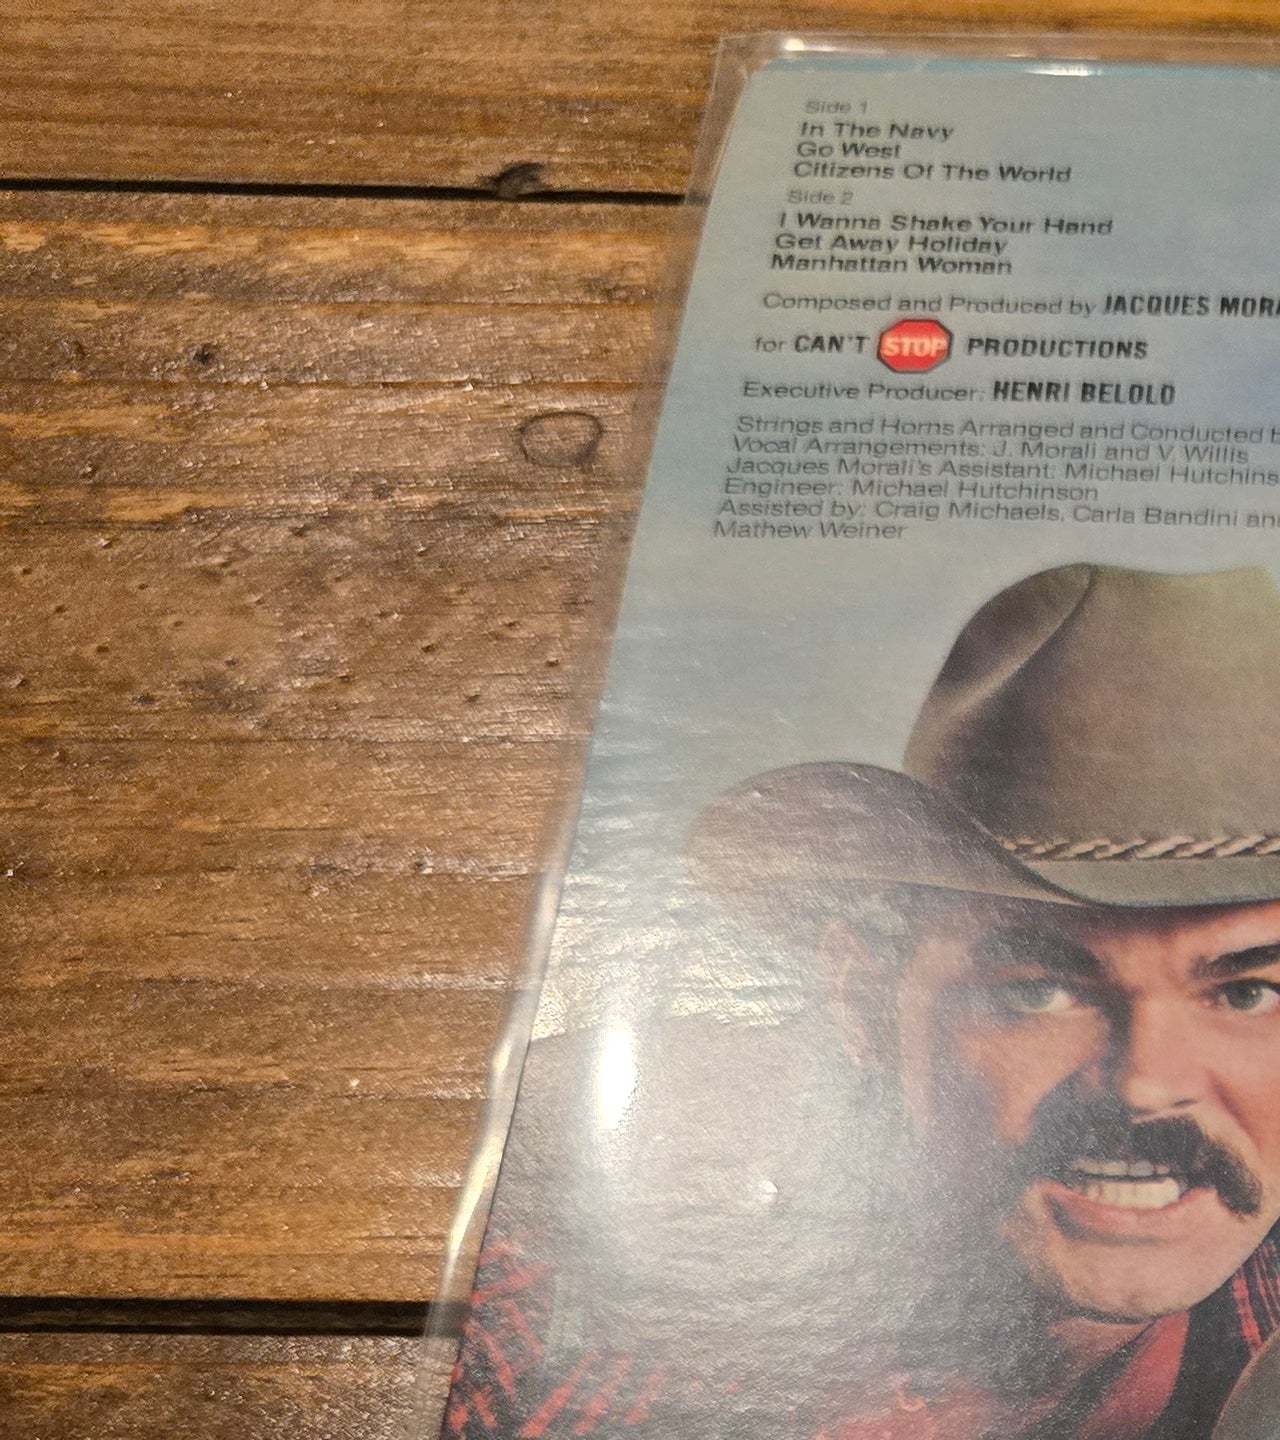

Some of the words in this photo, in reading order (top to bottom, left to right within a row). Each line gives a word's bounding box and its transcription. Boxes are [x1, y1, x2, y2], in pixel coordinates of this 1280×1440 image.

[805, 101, 851, 114] Side
[800, 122, 824, 137] In
[834, 122, 881, 138] The
[890, 123, 954, 142] Navy
[797, 142, 834, 157] Go
[841, 142, 901, 159] West
[794, 161, 895, 180] Citizens
[903, 163, 935, 179] Of
[942, 164, 989, 181] The
[999, 166, 1071, 182] World
[787, 190, 835, 204] Side
[840, 191, 853, 205] 2
[779, 212, 787, 228] I
[797, 213, 881, 230] Wanna
[890, 215, 972, 232] Shake
[979, 216, 1034, 234] Your
[1043, 218, 1113, 235] Hand
[775, 233, 820, 250] Get
[830, 234, 900, 254] Away
[908, 236, 1009, 256] Holiday
[770, 254, 908, 273] Manhattan
[917, 257, 1012, 275] Woman
[763, 294, 891, 312] Composed
[896, 297, 942, 312] and
[950, 297, 1062, 315] Produced
[1069, 300, 1094, 318] by
[1101, 295, 1210, 317] JACQUES
[755, 337, 787, 352] for
[794, 335, 870, 353] CAN'T
[880, 336, 948, 357] STOP
[967, 337, 1148, 360] PRODUCTIONS
[743, 381, 860, 399] Executive
[994, 381, 1070, 402] HENRI
[1081, 382, 1176, 405] BELOLO
[738, 416, 823, 436] Strings
[829, 418, 873, 434] and
[881, 418, 955, 436] Horns
[960, 419, 1074, 439] Arranged
[1080, 422, 1124, 440] and
[1131, 423, 1264, 443] Conducted
[734, 436, 797, 454] Vocal
[992, 441, 1012, 457] J.
[1022, 441, 1095, 459] Morali
[1104, 444, 1150, 460] and
[1184, 446, 1248, 464] Willis
[727, 457, 828, 476] Jacques
[838, 458, 931, 476] Morali's
[1065, 462, 1161, 482] Michael
[852, 479, 948, 498] Michael
[958, 481, 1099, 501] Hutchinson
[718, 499, 823, 517] Assisted
[875, 501, 940, 521] Craig
[1071, 504, 1136, 524] Carla
[1143, 506, 1239, 527] Bandini
[712, 520, 813, 539] Mathew
[817, 522, 906, 540] Weiner
